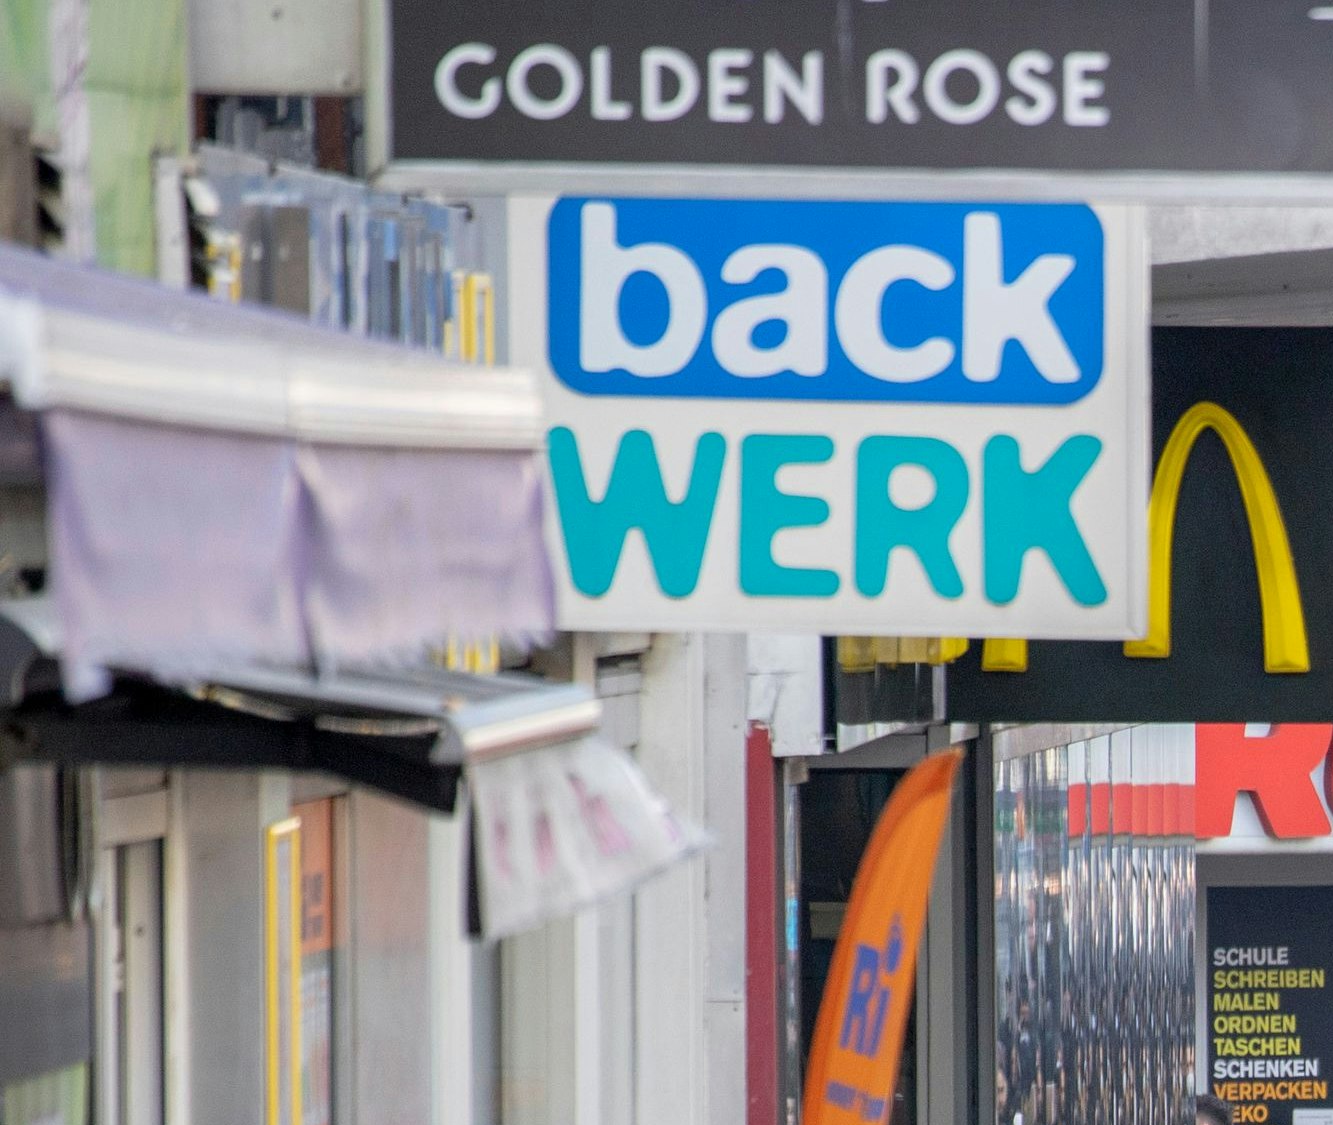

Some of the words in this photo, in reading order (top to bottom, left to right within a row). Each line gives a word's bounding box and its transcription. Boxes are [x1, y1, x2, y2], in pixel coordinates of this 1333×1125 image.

[434, 42, 824, 125] GOLDEN
[866, 48, 1110, 128] ROSE
[580, 202, 1082, 384] back
[548, 426, 1108, 608] WERK
[1213, 947, 1289, 967] SCHULE
[1213, 968, 1326, 989] SCHREIBEN
[1213, 992, 1280, 1012] MALEN
[1213, 1015, 1297, 1034] ORDNEN
[1213, 1037, 1302, 1057] TASCHEN
[1213, 1059, 1319, 1079] SCHENKEN
[1213, 1081, 1328, 1101] VERPACKEN
[1231, 1104, 1269, 1124] EKO
